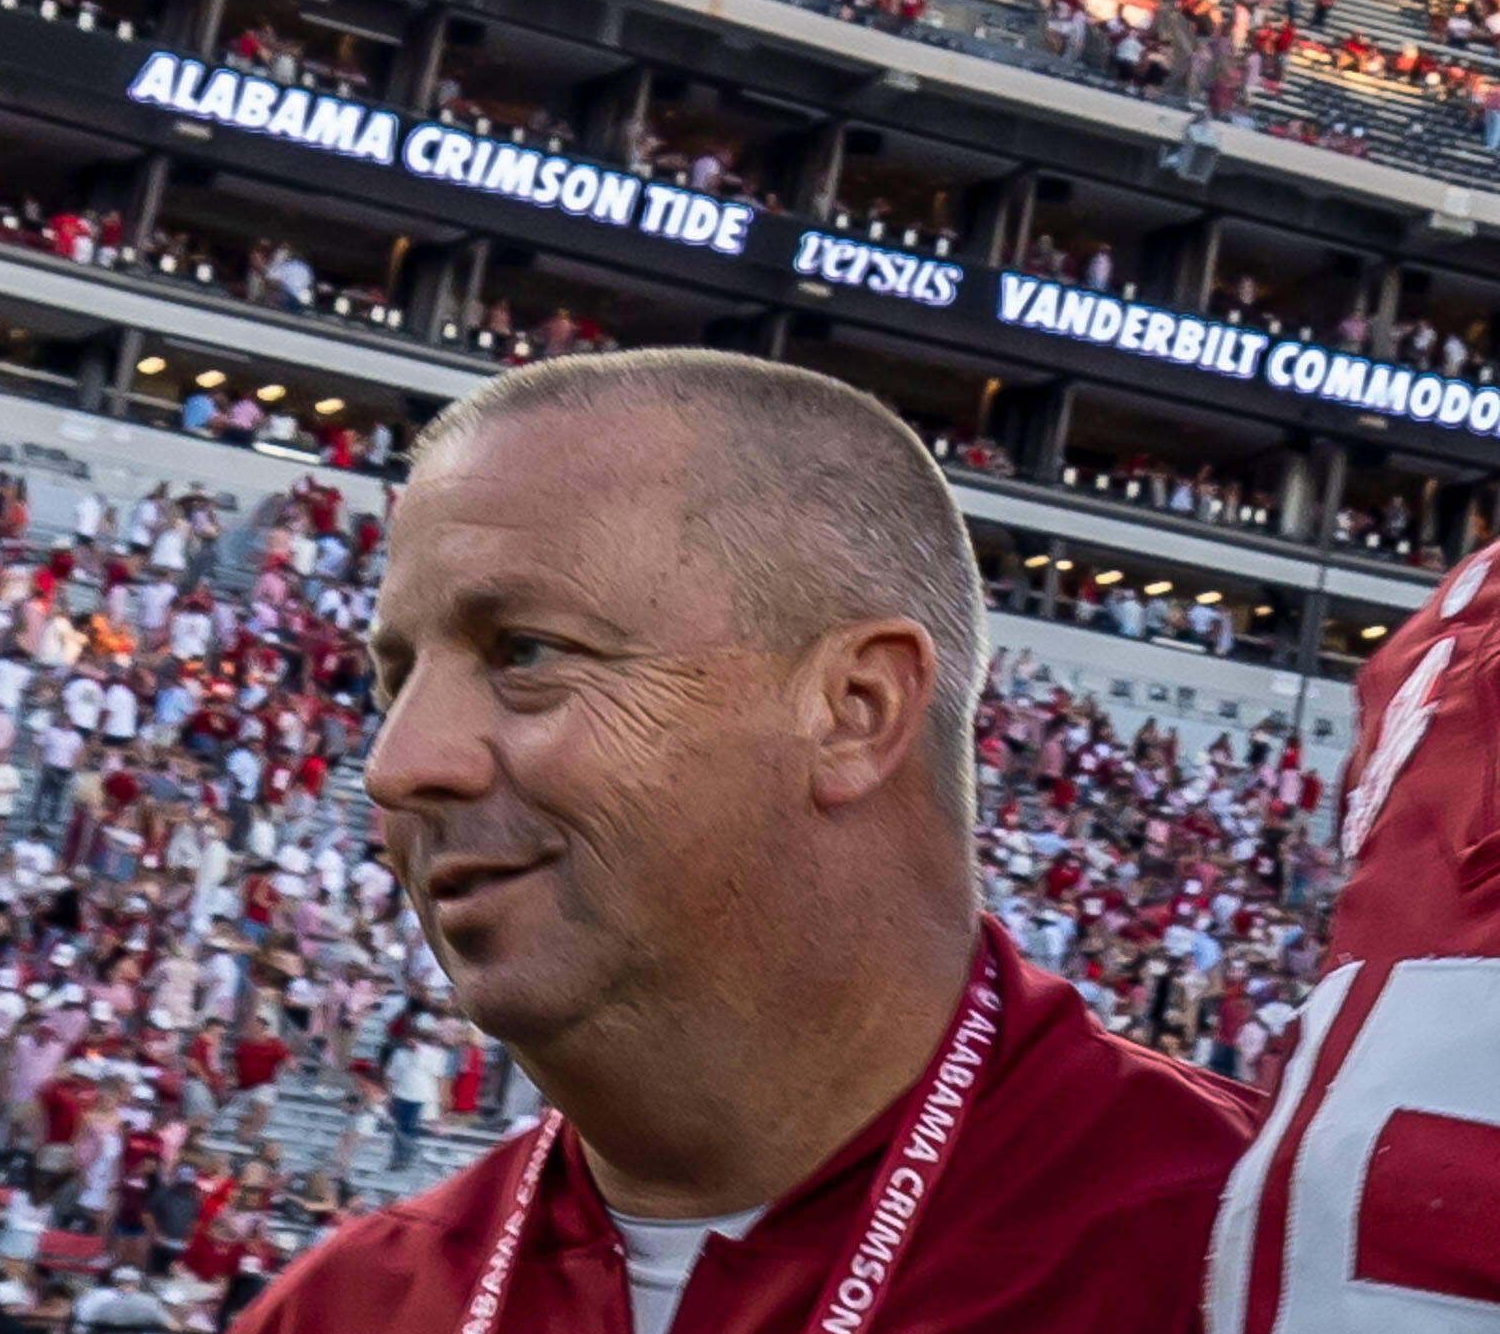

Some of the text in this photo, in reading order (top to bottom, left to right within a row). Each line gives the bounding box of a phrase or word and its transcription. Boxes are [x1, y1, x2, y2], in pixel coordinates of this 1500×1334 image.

[126, 52, 400, 165] ALABAMA
[403, 121, 641, 225] CRIMSON
[638, 180, 753, 255] TIDE
[793, 232, 963, 306] versus
[997, 273, 1268, 379] VANDERBILT
[903, 1009, 997, 1163] ALABAMA
